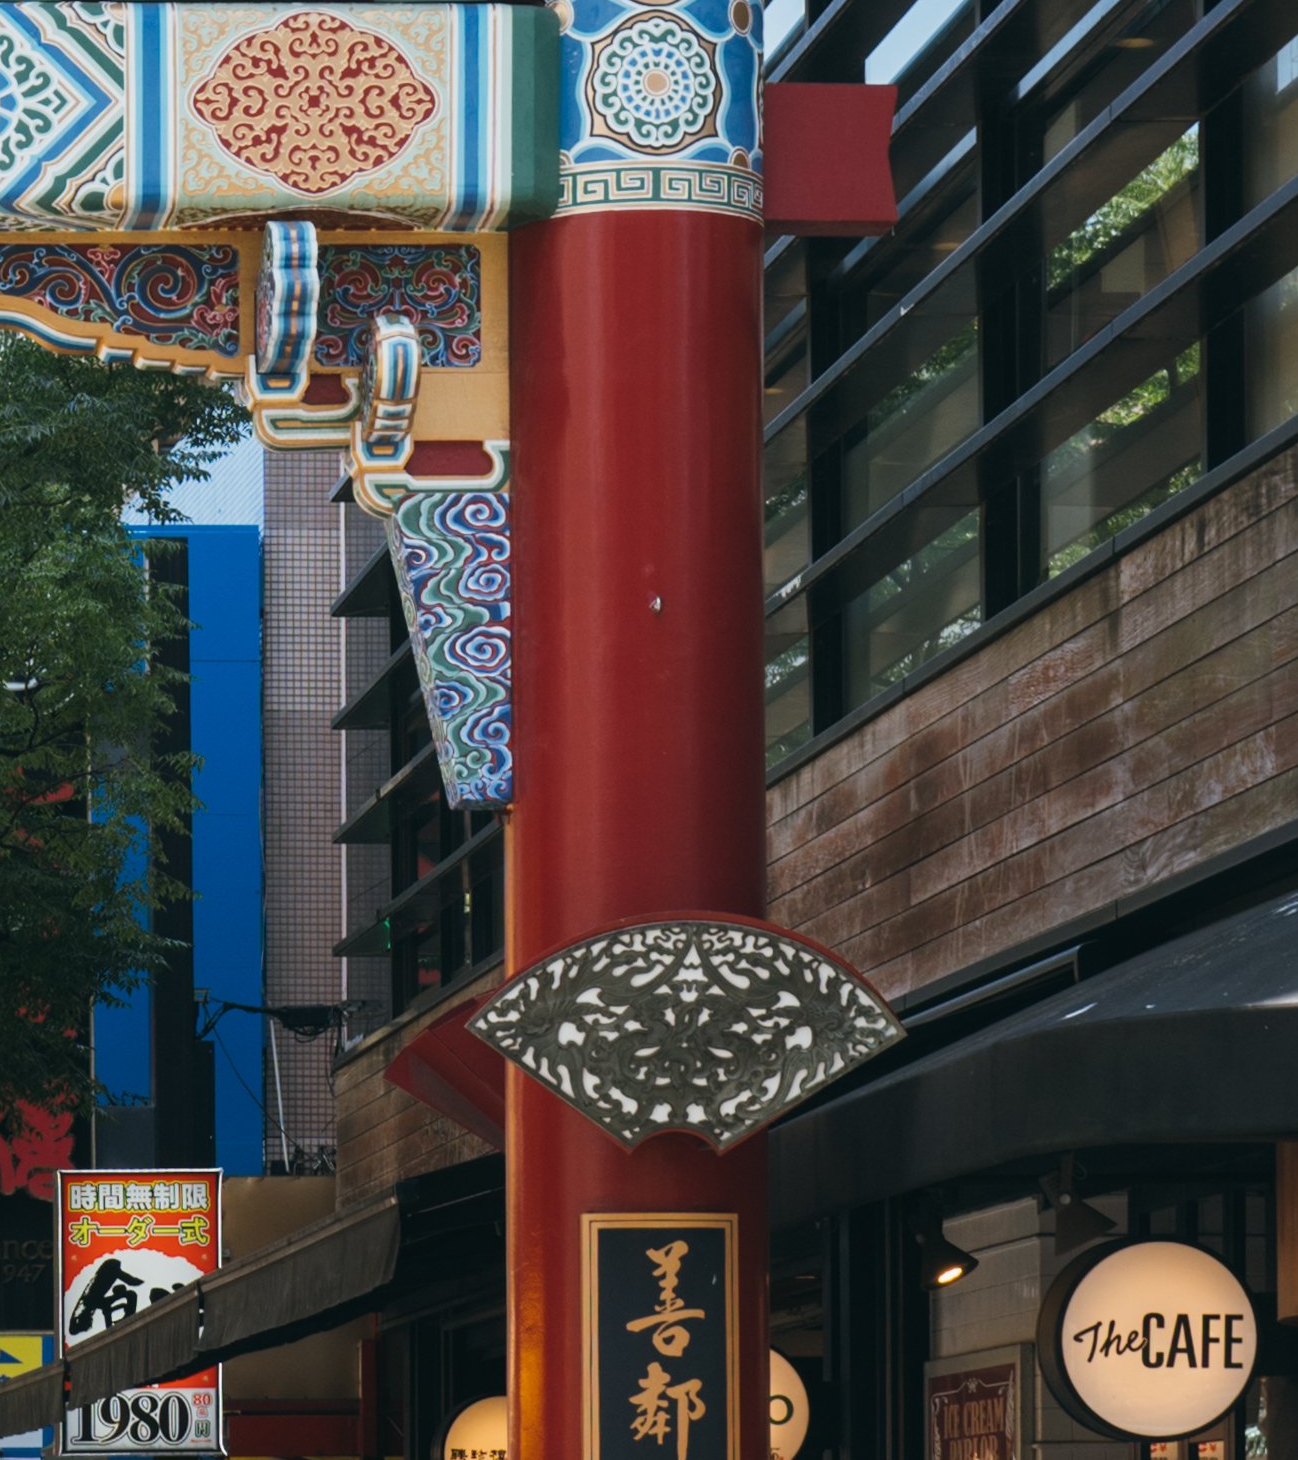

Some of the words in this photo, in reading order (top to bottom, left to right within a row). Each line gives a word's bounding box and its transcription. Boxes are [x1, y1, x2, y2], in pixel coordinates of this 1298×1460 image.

[69, 1181, 209, 1212] 時間無制限
[69, 1216, 210, 1246] オーダー式
[1072, 1320, 1149, 1364] The
[1142, 1312, 1245, 1370] CAFE
[71, 1392, 192, 1446] 1980
[962, 1396, 1006, 1435] CREAM
